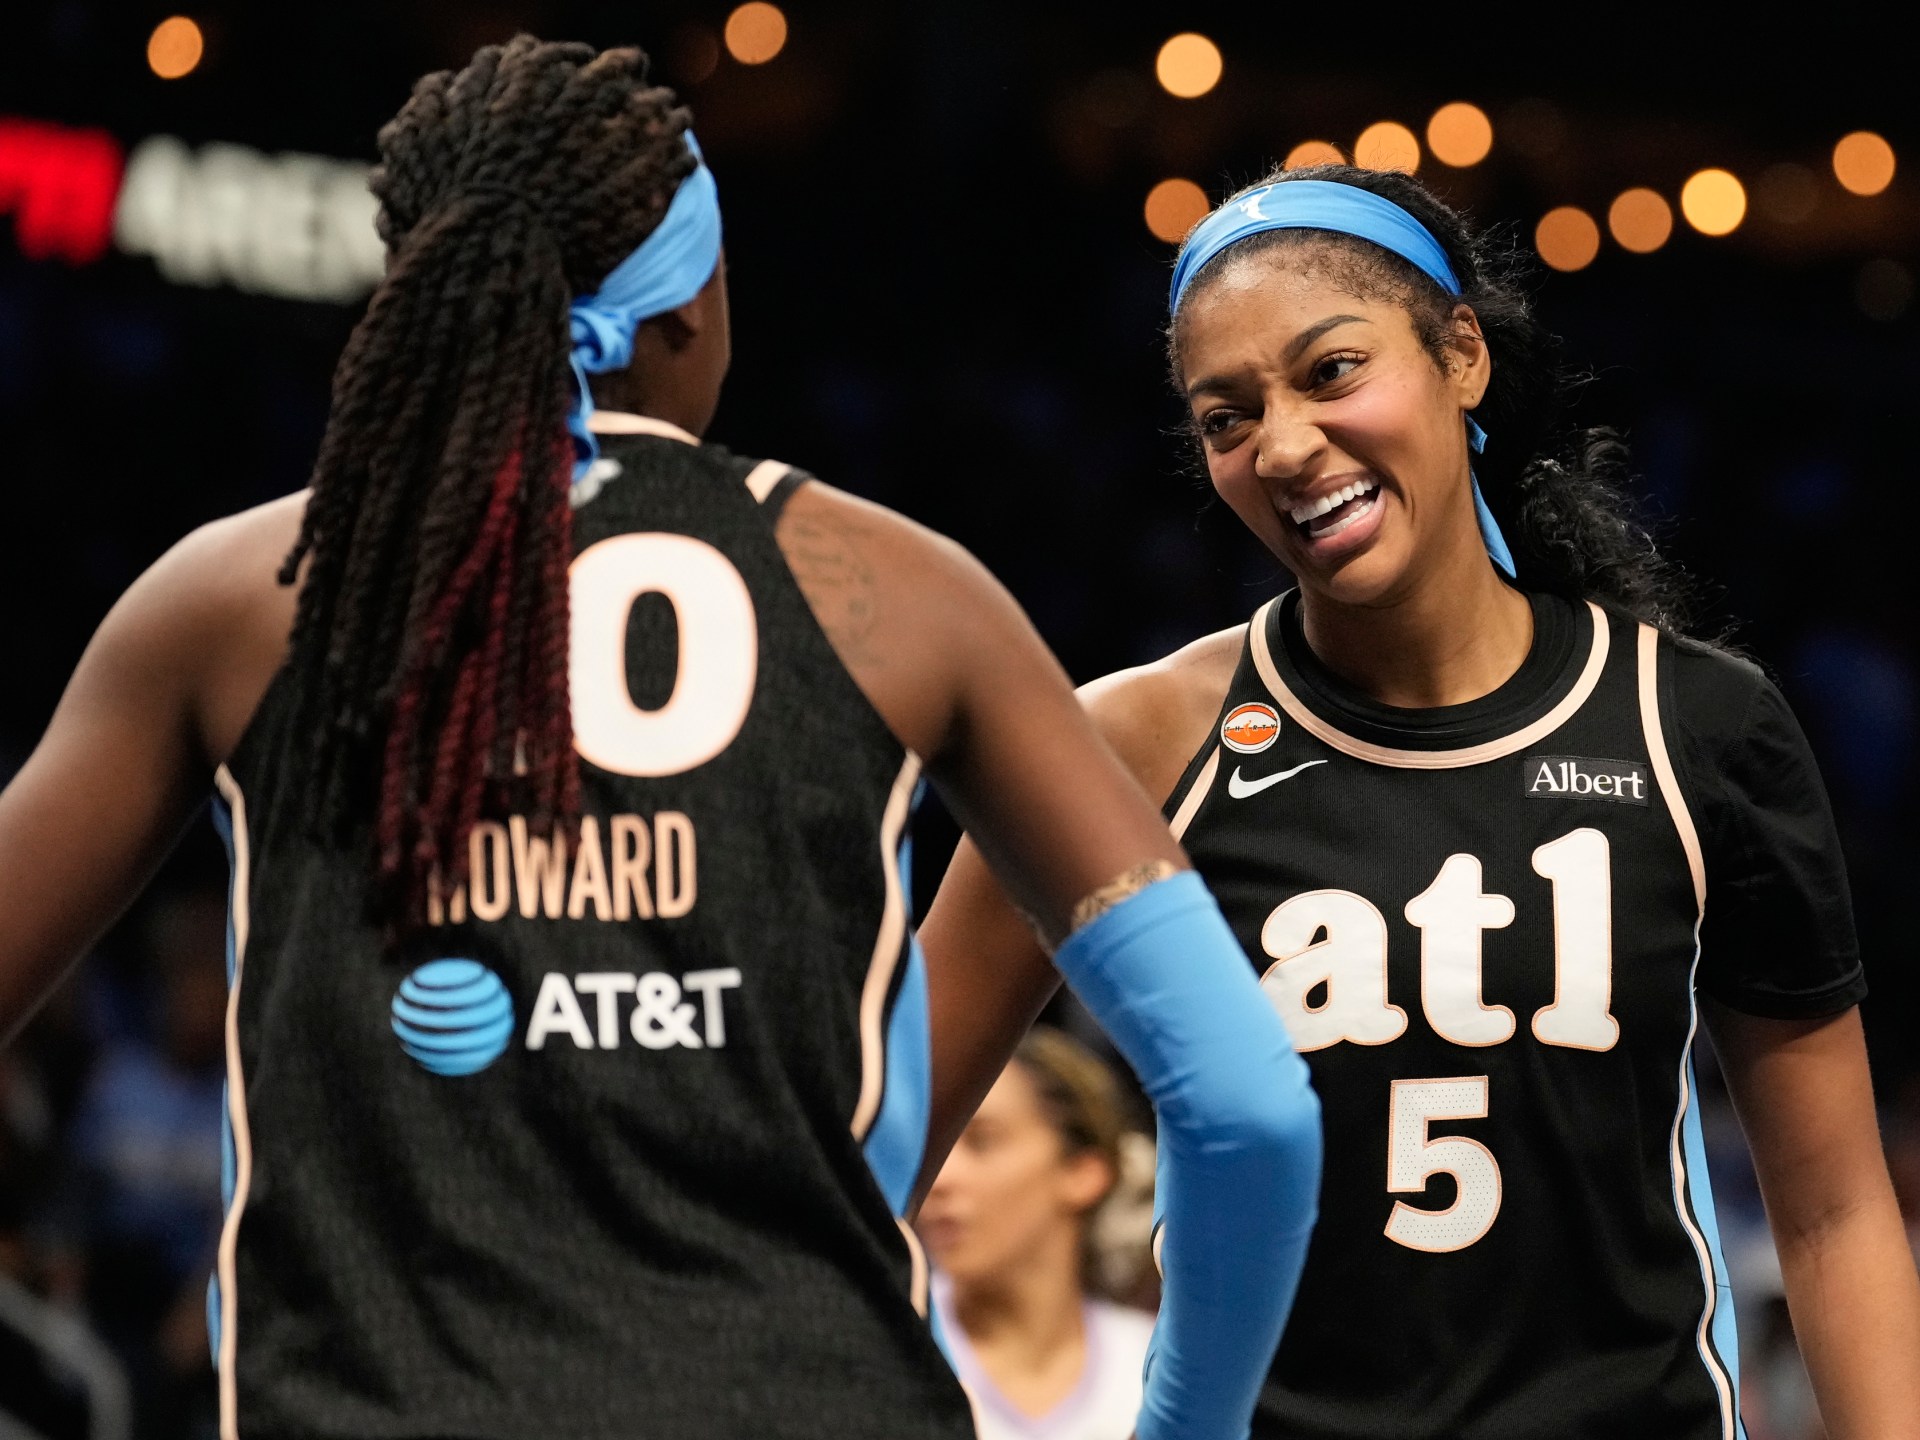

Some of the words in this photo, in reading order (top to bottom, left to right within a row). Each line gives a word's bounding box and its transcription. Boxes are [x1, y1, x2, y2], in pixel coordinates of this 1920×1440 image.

[1530, 761, 1644, 799] Albert
[1259, 827, 1620, 1052] atl
[525, 968, 742, 1050] AT&T
[1384, 1075, 1502, 1253] 5
